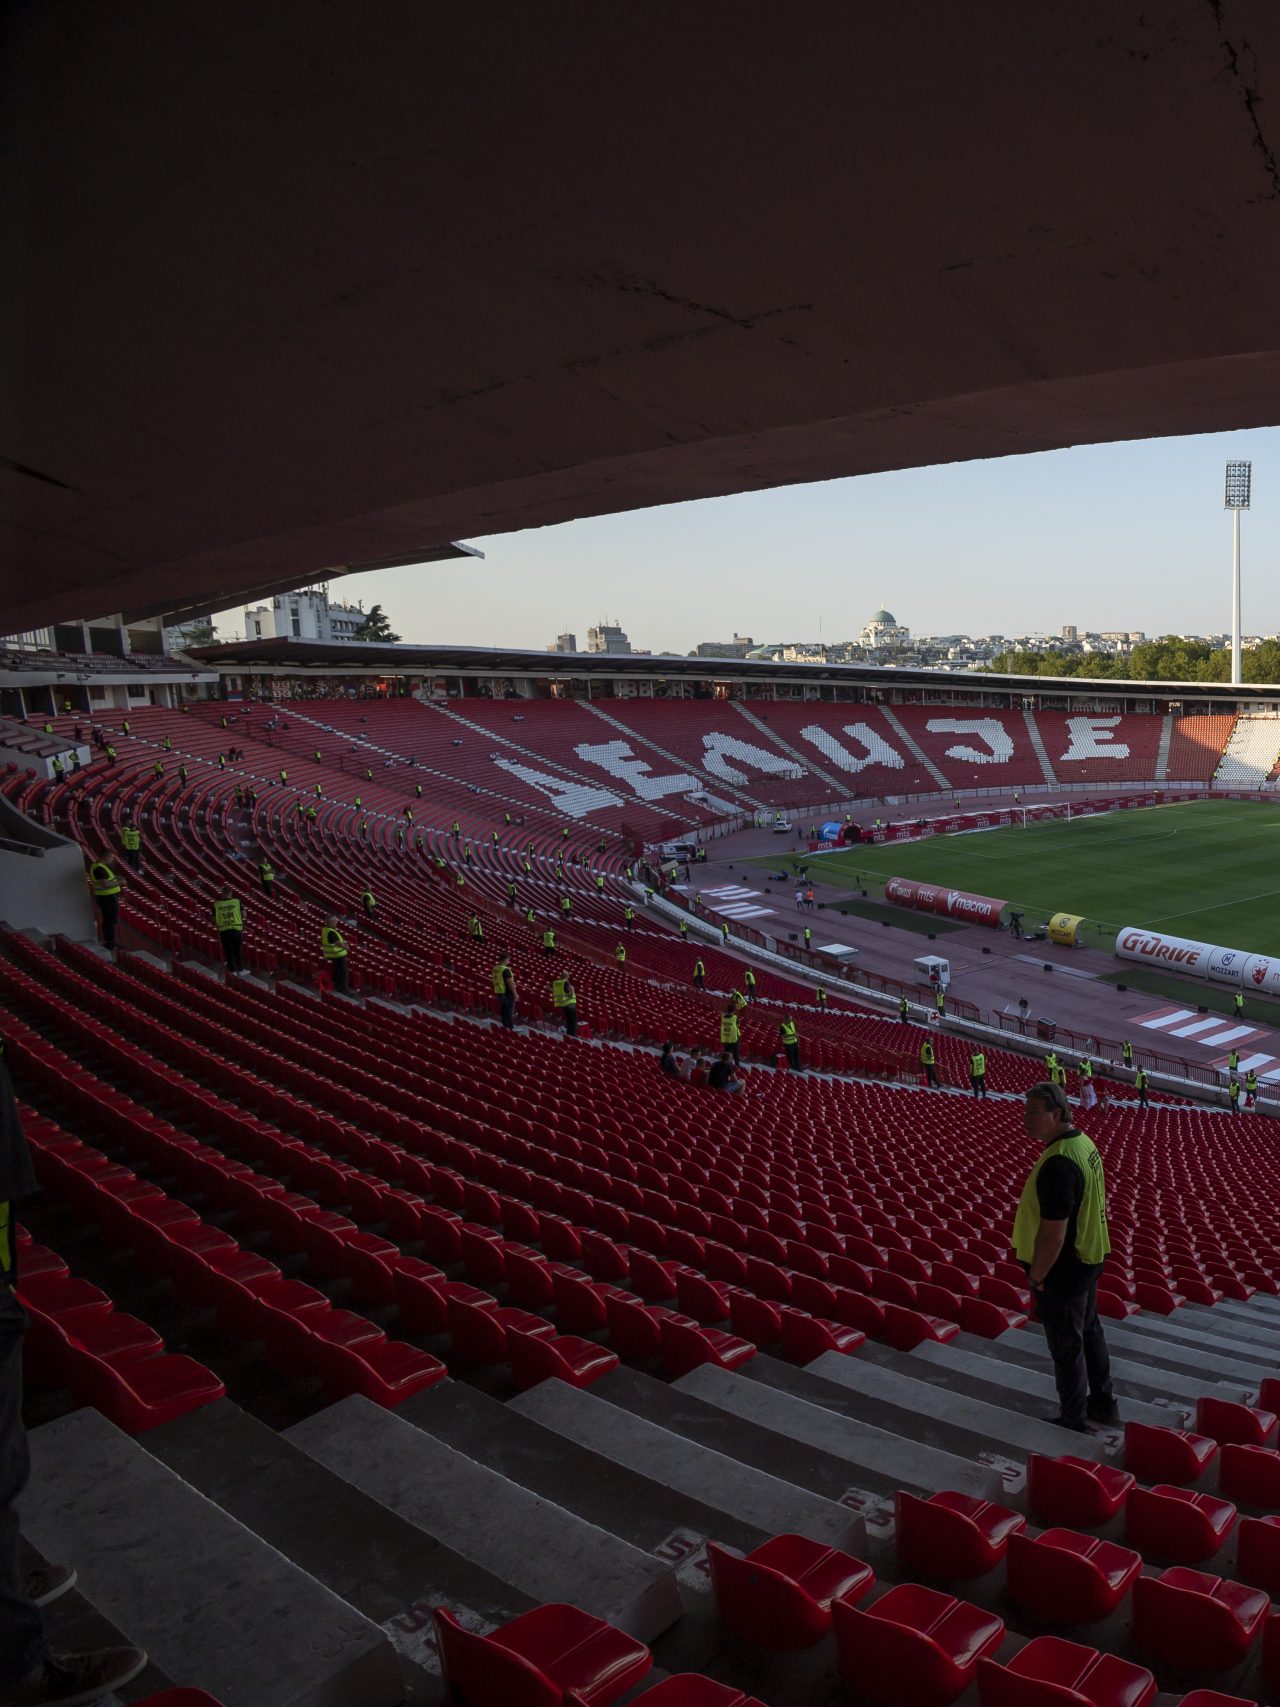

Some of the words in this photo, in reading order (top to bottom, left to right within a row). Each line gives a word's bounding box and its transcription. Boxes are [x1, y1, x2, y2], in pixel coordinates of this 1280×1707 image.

[917, 890, 935, 902] mts
[955, 897, 992, 916] macron
[1051, 929, 1071, 937] MOZZART
[1210, 966, 1240, 977] MOZZART
